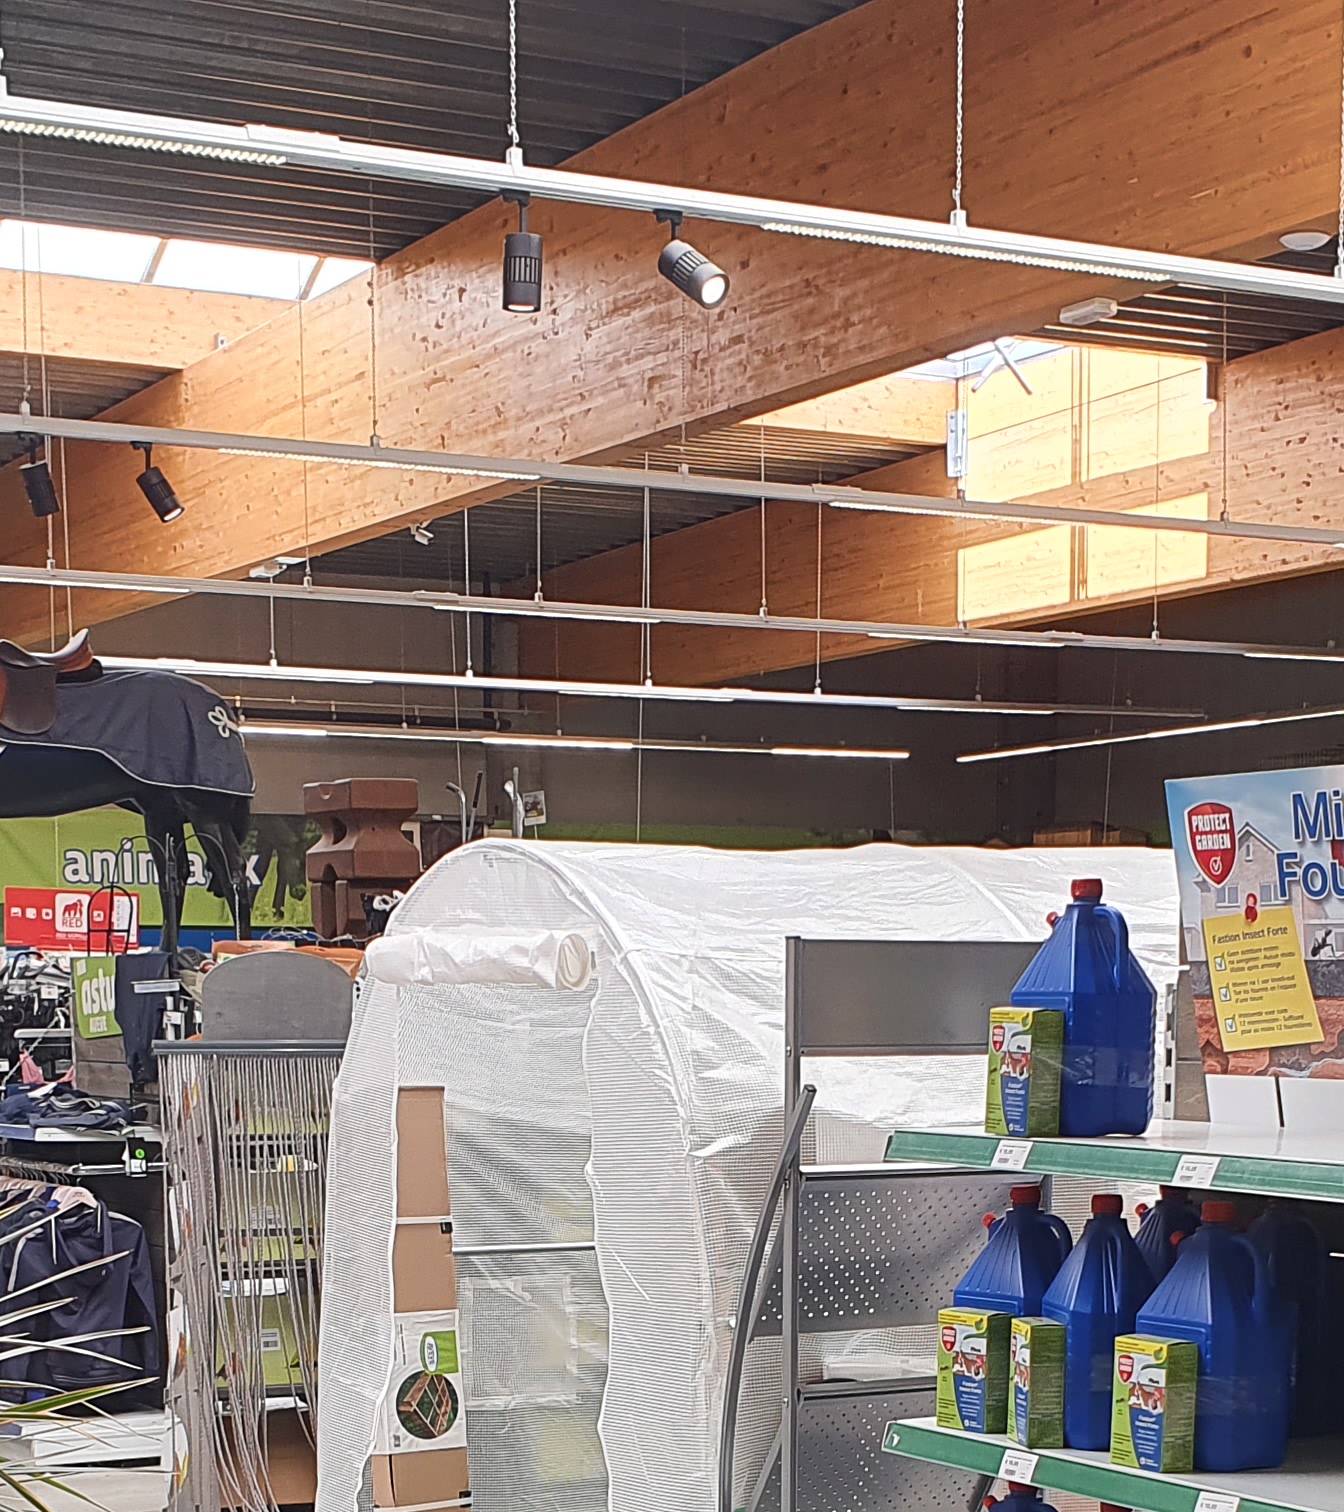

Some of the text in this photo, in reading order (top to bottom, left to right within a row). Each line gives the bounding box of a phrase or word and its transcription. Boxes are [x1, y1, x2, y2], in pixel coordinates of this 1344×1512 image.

[1191, 811, 1231, 831] PROTECT
[1195, 834, 1231, 852] GARDEN
[61, 918, 84, 928] RED
[1242, 929, 1265, 941] Insect
[1267, 926, 1289, 937] Forte
